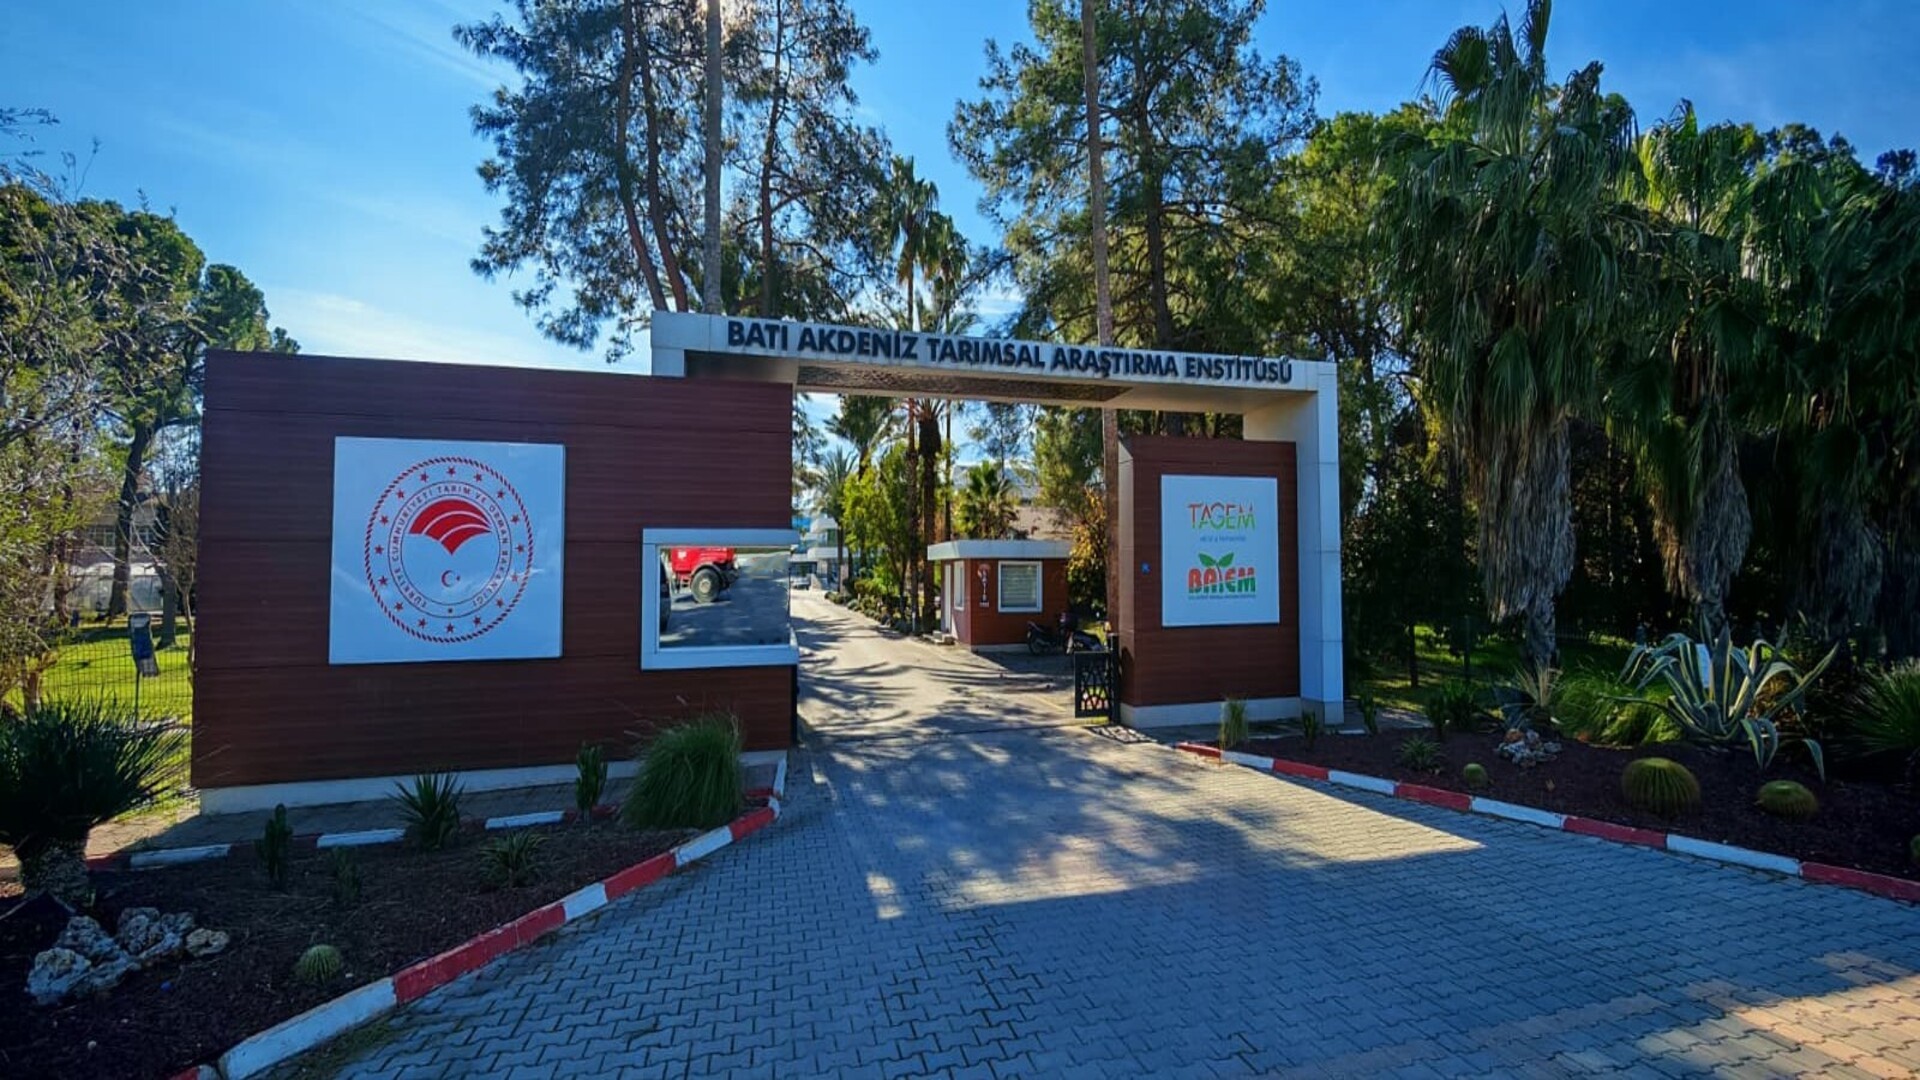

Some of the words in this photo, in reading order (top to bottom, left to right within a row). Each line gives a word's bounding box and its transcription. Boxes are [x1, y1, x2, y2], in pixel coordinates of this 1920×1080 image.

[727, 321, 788, 351] BATI
[798, 326, 919, 360] AKDENİZ
[926, 338, 1046, 368] TARIMSAL
[1052, 349, 1179, 378] ARAŞTIRMA
[1185, 355, 1293, 384] ENSTİTÜSÜ
[1187, 501, 1256, 531] TAGEM
